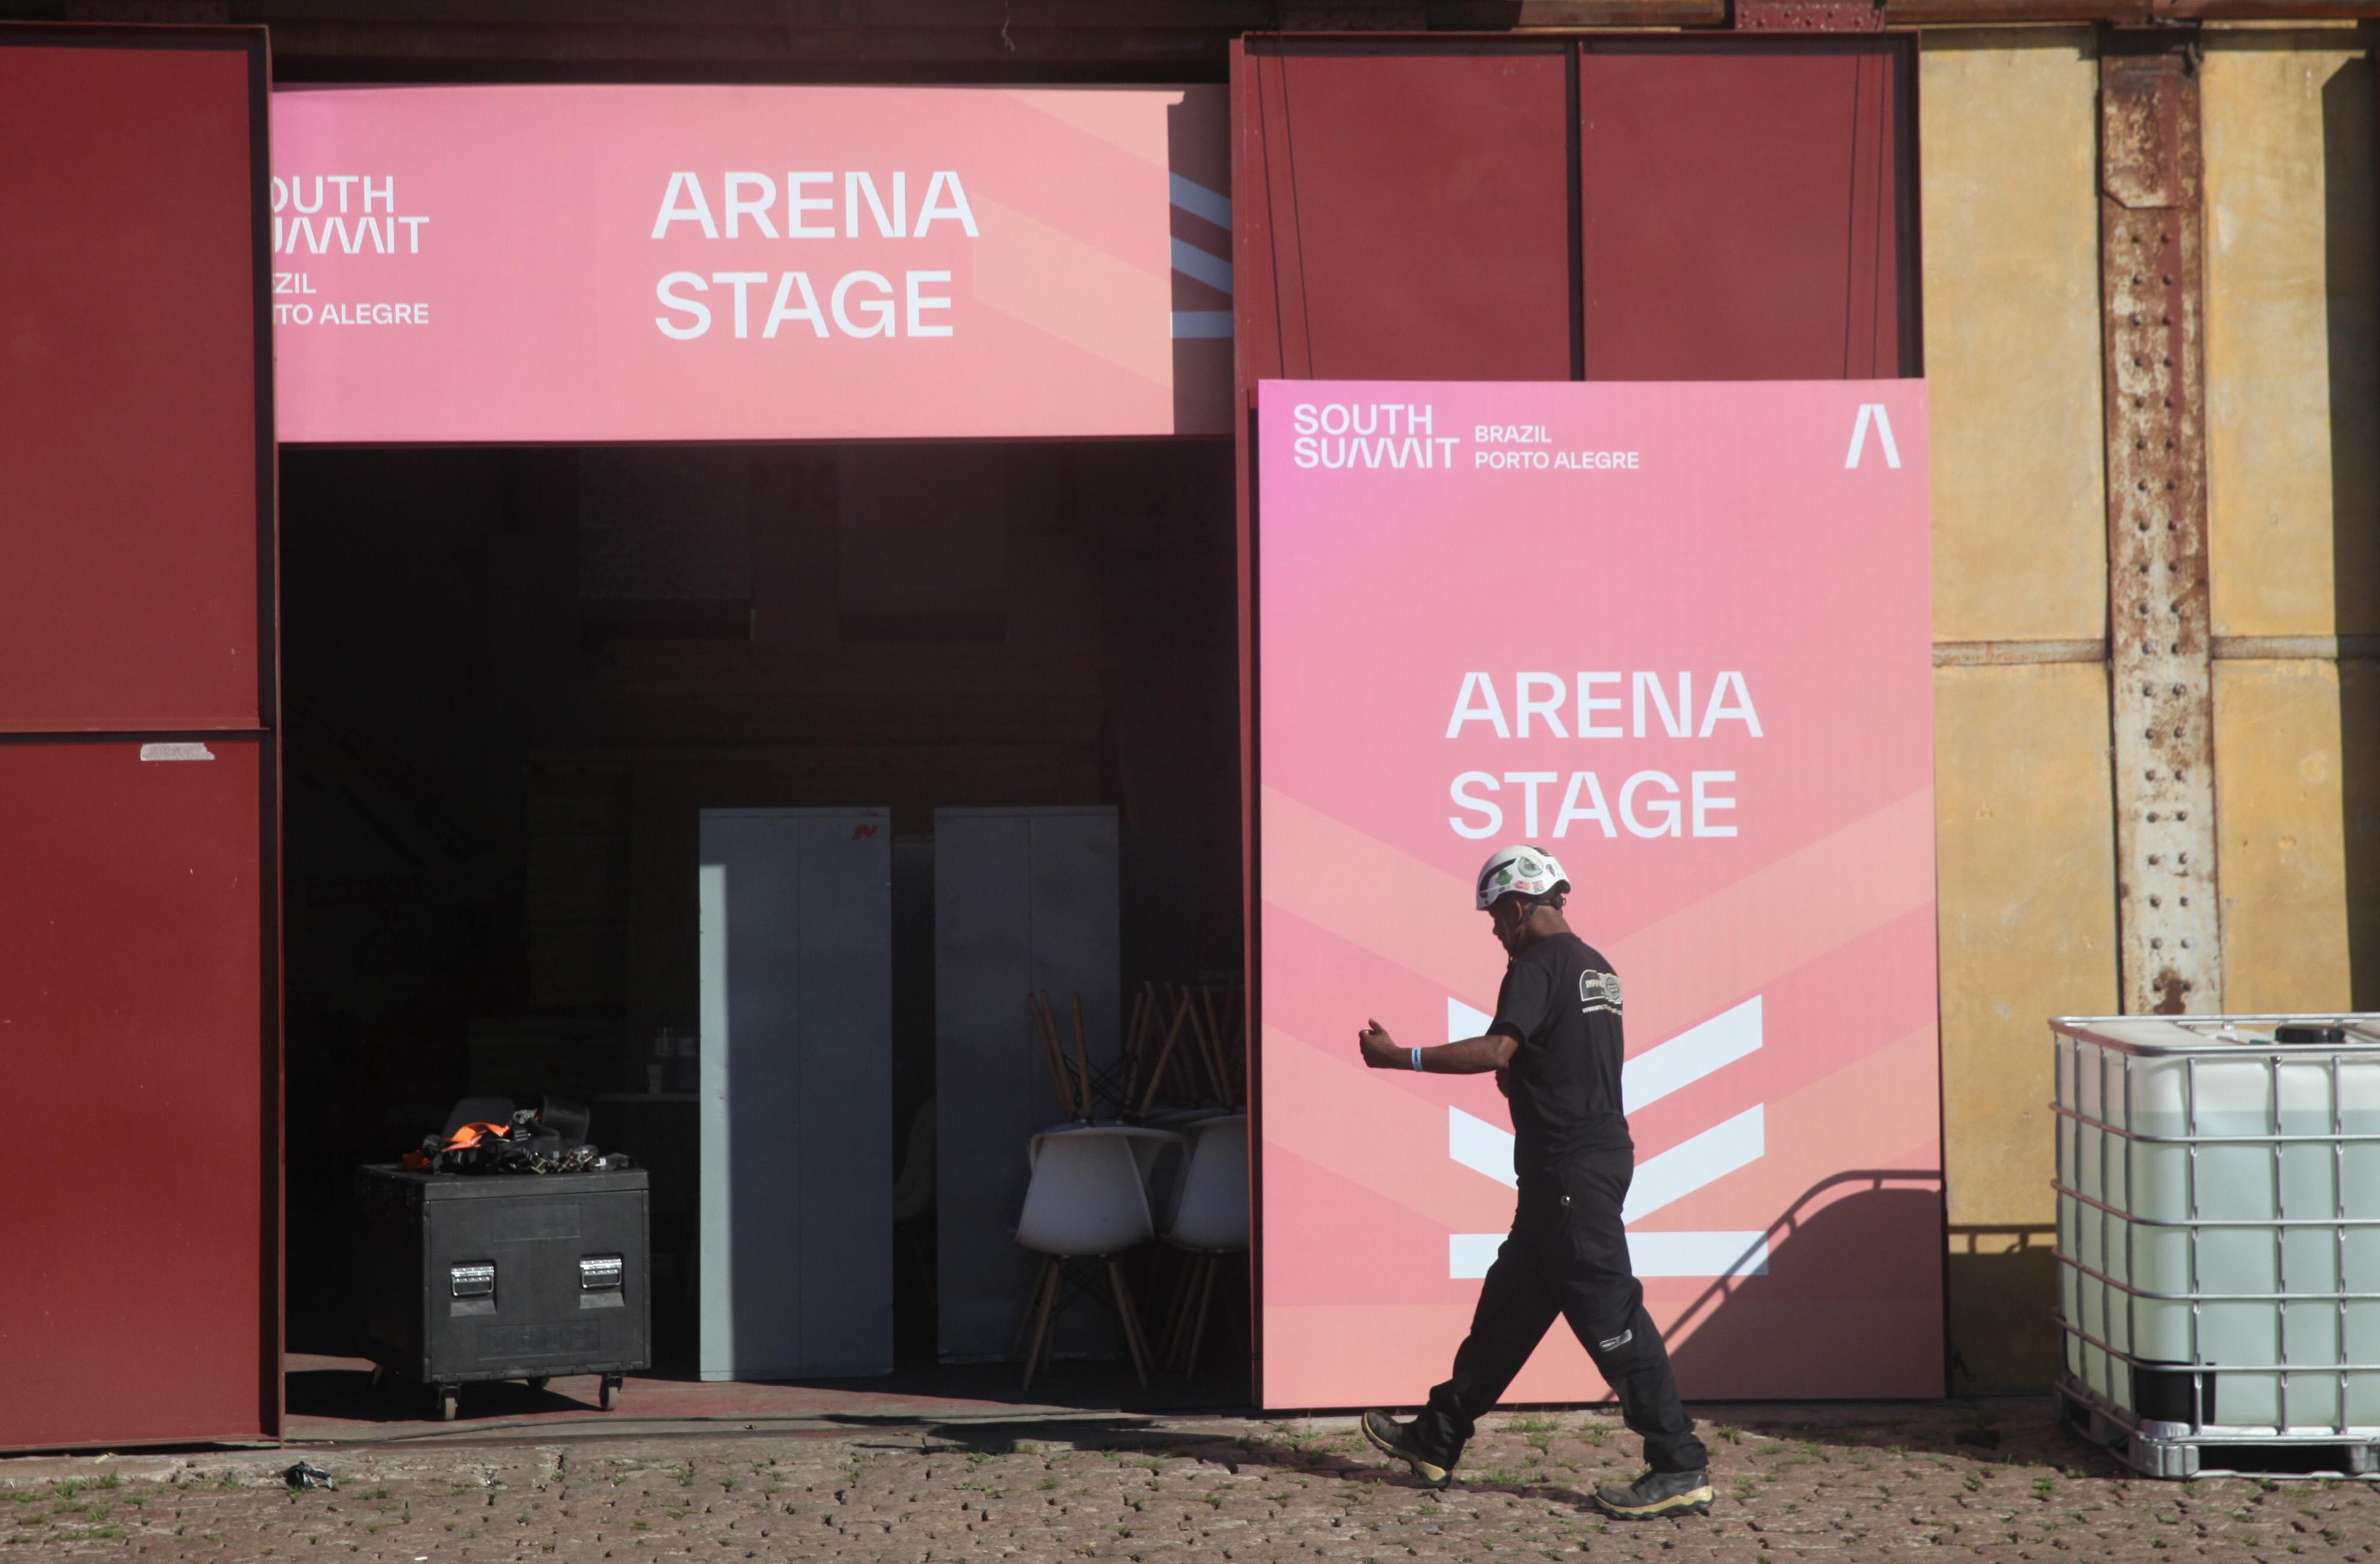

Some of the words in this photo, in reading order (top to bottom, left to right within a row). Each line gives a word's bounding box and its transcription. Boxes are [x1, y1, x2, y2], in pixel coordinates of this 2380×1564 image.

[650, 170, 984, 240] ARENA
[273, 272, 316, 294] ZIL
[273, 303, 314, 325] TO
[319, 303, 429, 325] ALEGRE
[654, 269, 954, 341] STAGE
[1292, 403, 1433, 436] SOUTH
[1474, 424, 1552, 444] BRAZIL
[1293, 437, 1461, 469] SUMMIT
[1474, 450, 1550, 470] PORTO
[1553, 450, 1641, 470] ALEGRE
[1445, 670, 1765, 740] ARENA
[1447, 769, 1739, 841] STAGE
